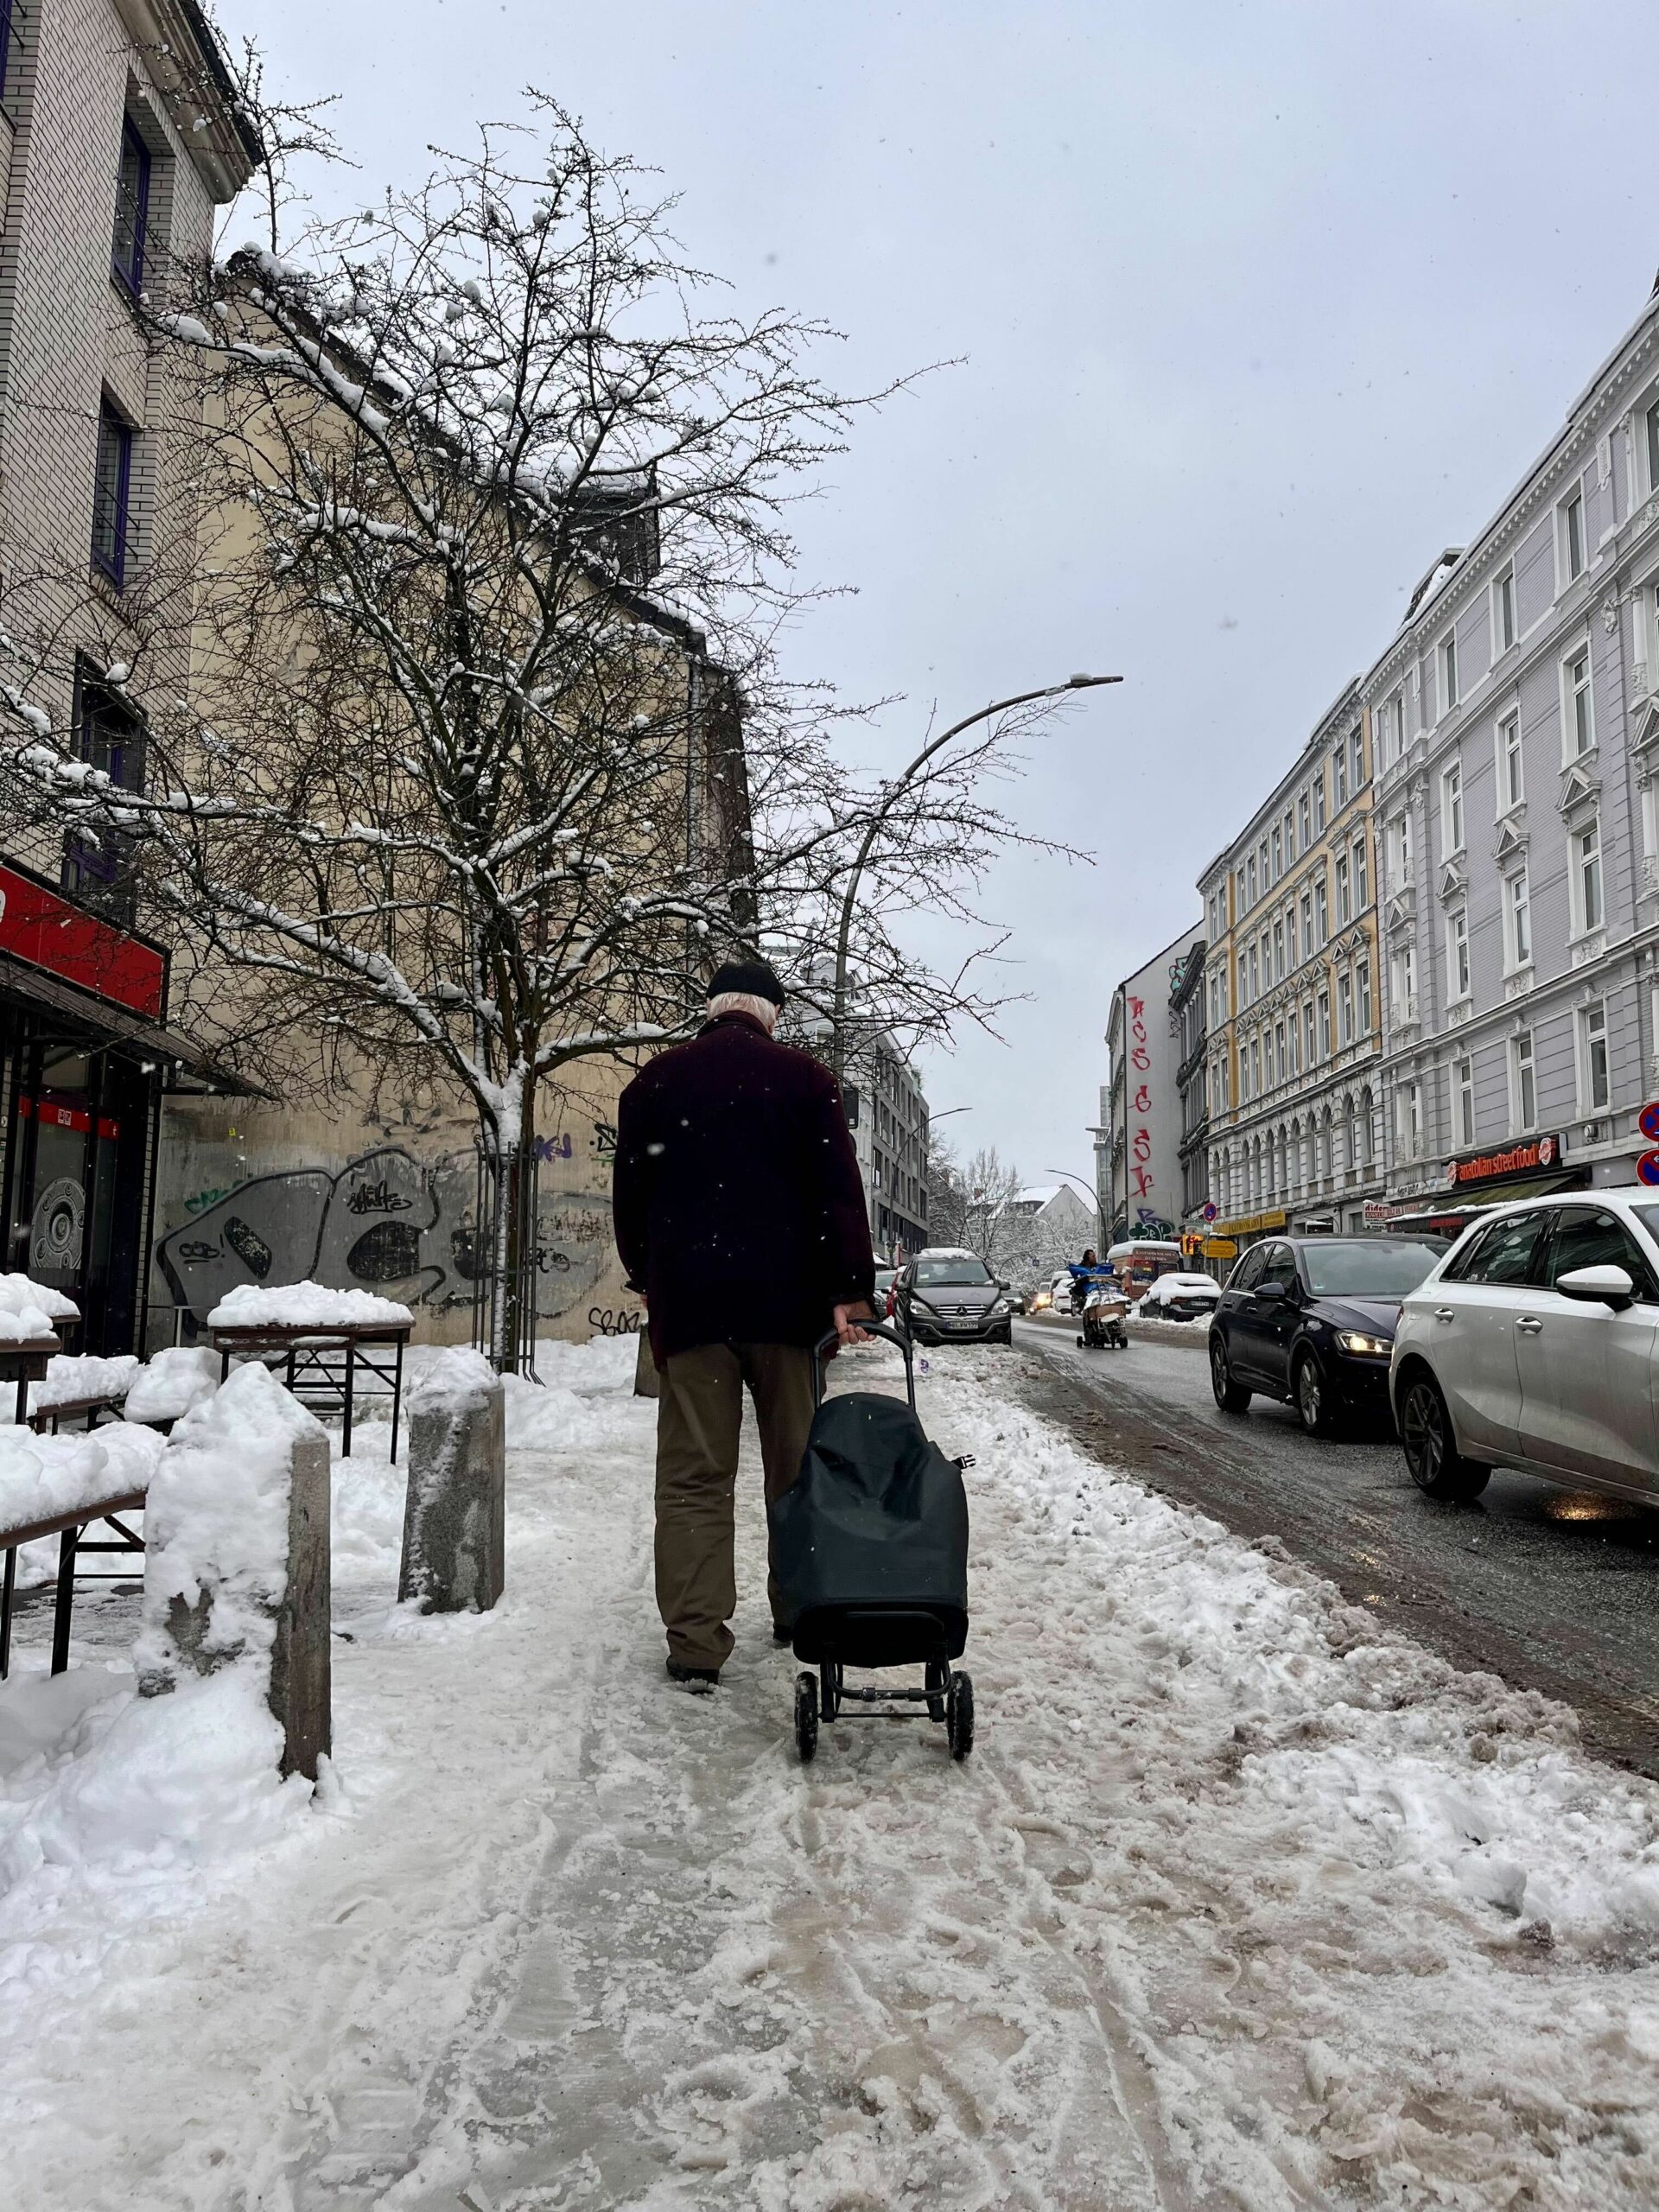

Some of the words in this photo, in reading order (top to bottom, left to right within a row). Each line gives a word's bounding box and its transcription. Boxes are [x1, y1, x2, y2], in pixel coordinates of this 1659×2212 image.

[1459, 1156, 1492, 1181] anatolian
[1493, 1149, 1516, 1174] street
[1516, 1143, 1538, 1169] food
